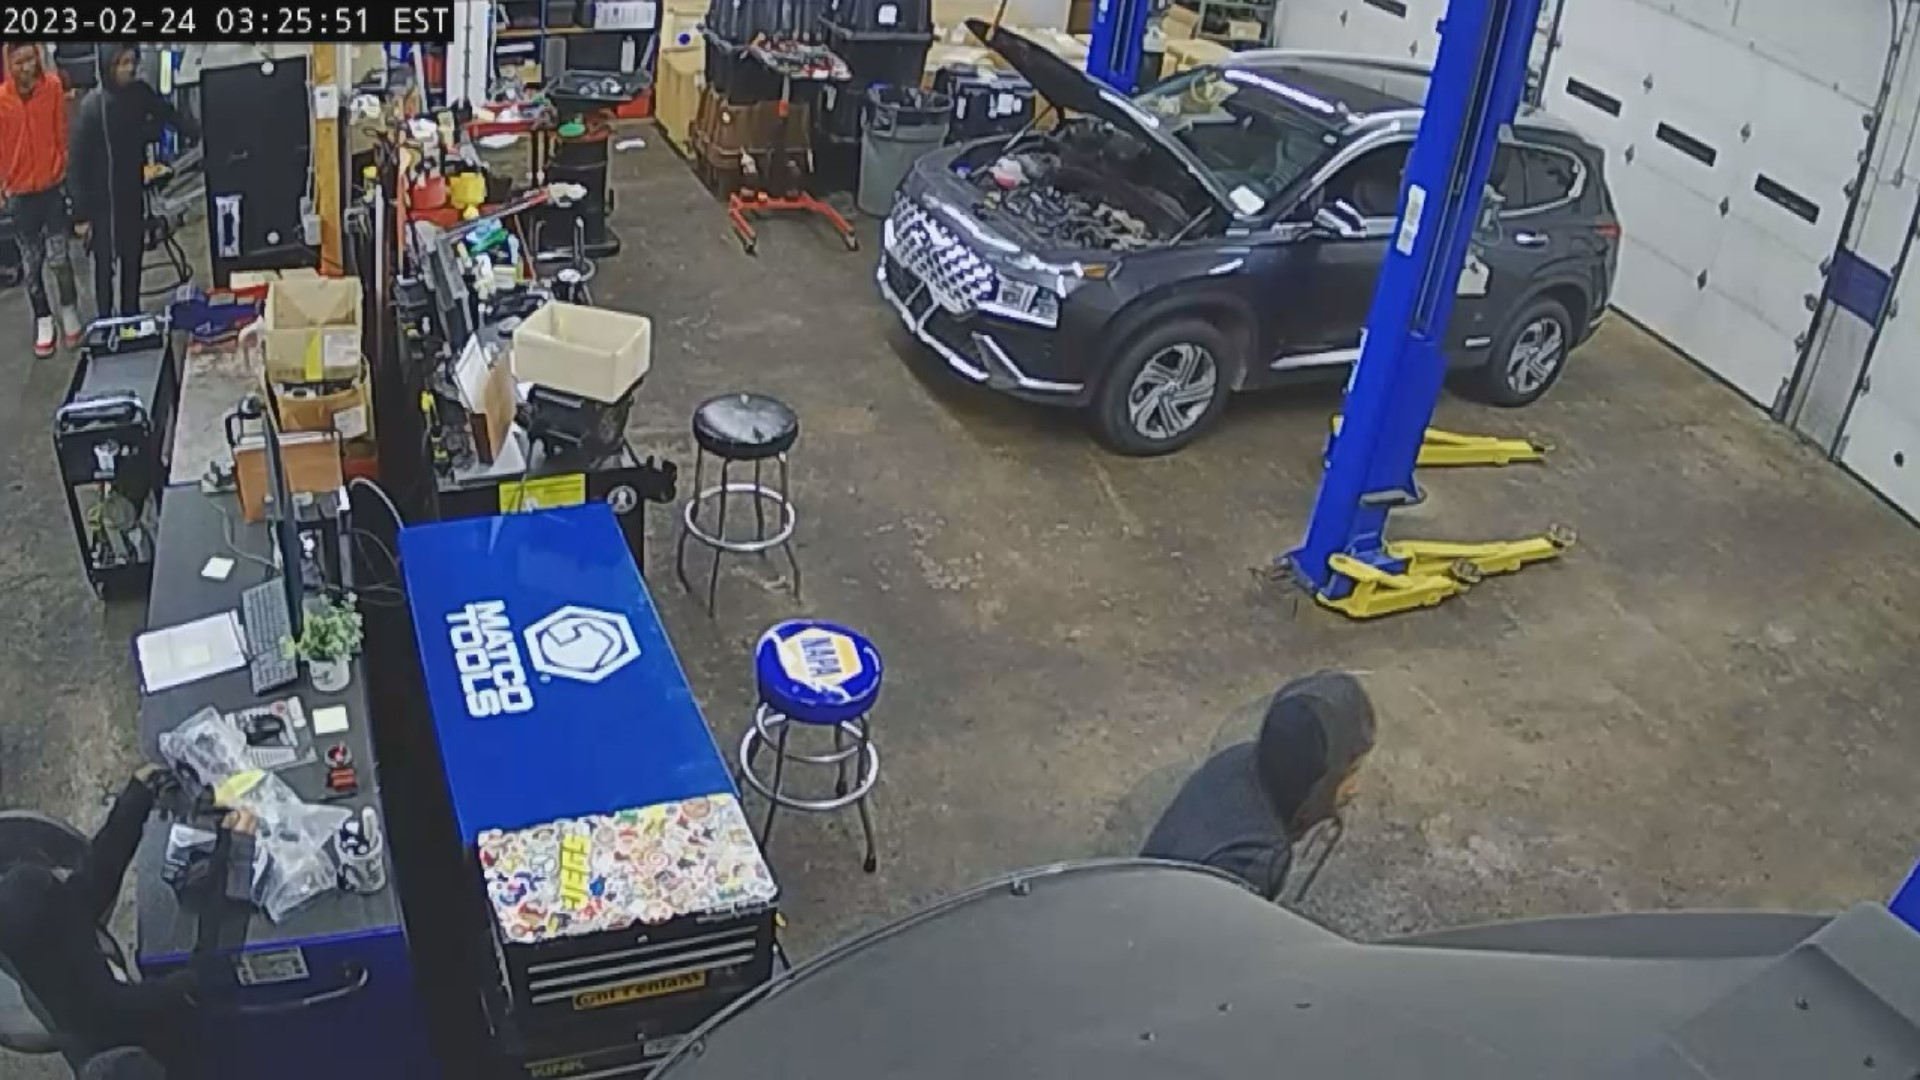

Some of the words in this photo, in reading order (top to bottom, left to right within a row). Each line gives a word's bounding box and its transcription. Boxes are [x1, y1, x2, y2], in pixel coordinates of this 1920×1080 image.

[446, 603, 502, 718] TOOLS
[474, 599, 534, 714] MATCO
[799, 637, 843, 678] NAPA
